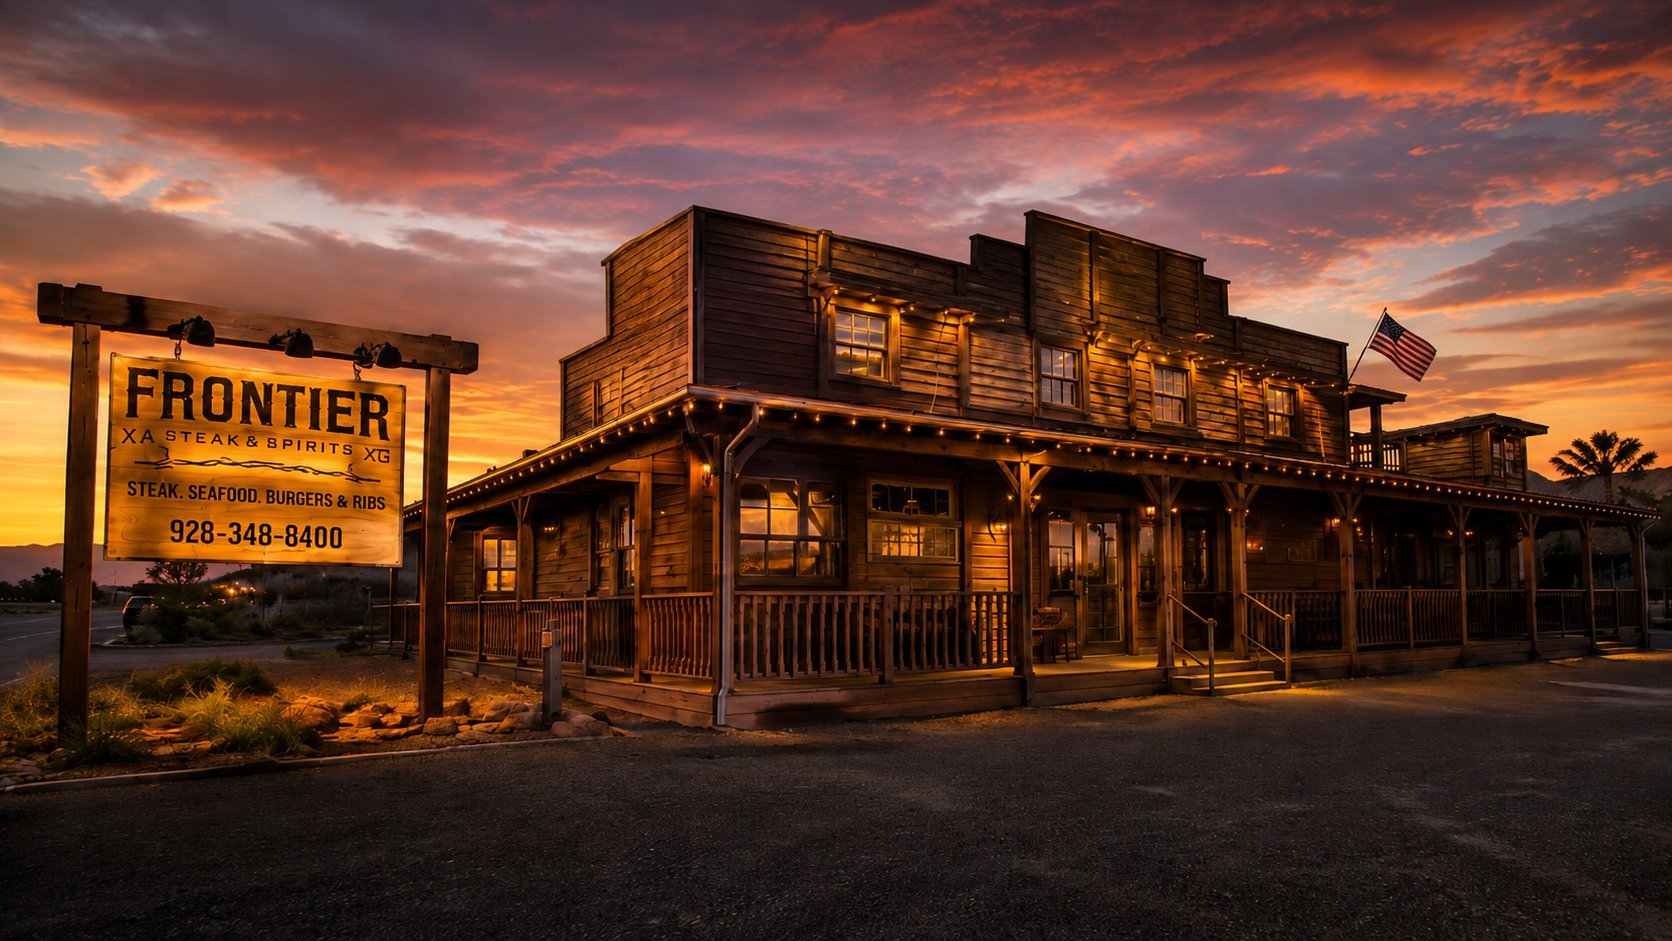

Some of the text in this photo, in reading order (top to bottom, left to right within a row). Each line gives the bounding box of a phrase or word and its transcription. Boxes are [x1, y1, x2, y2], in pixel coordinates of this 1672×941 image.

[125, 366, 390, 441] FRONTIER
[121, 427, 154, 444] XA
[165, 430, 239, 446] STEAK
[246, 435, 258, 447] &
[267, 437, 353, 455] SPIRITS
[266, 489, 333, 507] BURGERS
[337, 494, 347, 508] &
[353, 495, 386, 510] RIBS
[170, 519, 343, 549] 928-348-8400
